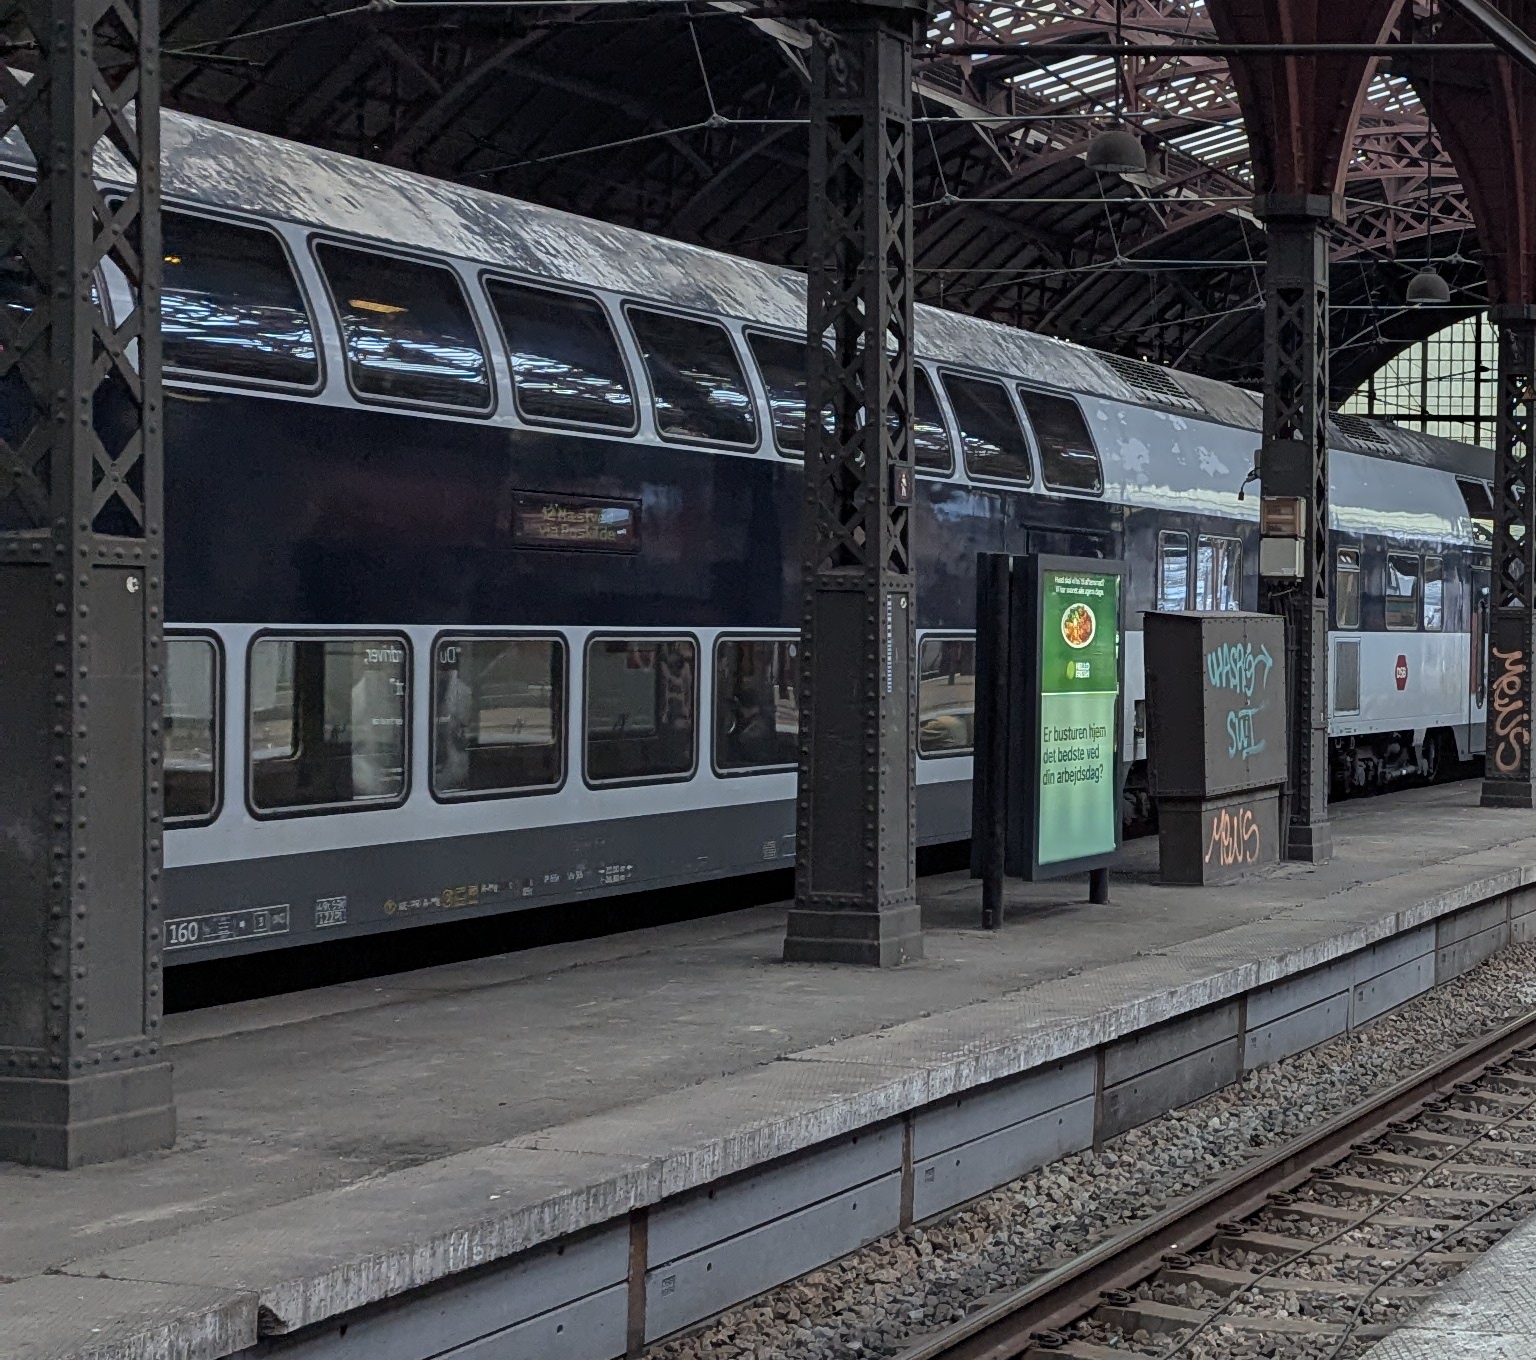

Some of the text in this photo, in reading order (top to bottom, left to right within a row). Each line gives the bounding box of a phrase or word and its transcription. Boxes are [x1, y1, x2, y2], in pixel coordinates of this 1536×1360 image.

[1044, 723, 1106, 742] Er busturen hjem
[1043, 744, 1100, 764] det bedste ved
[1043, 764, 1104, 786] din arbejdsdag?
[169, 921, 199, 944] 160
